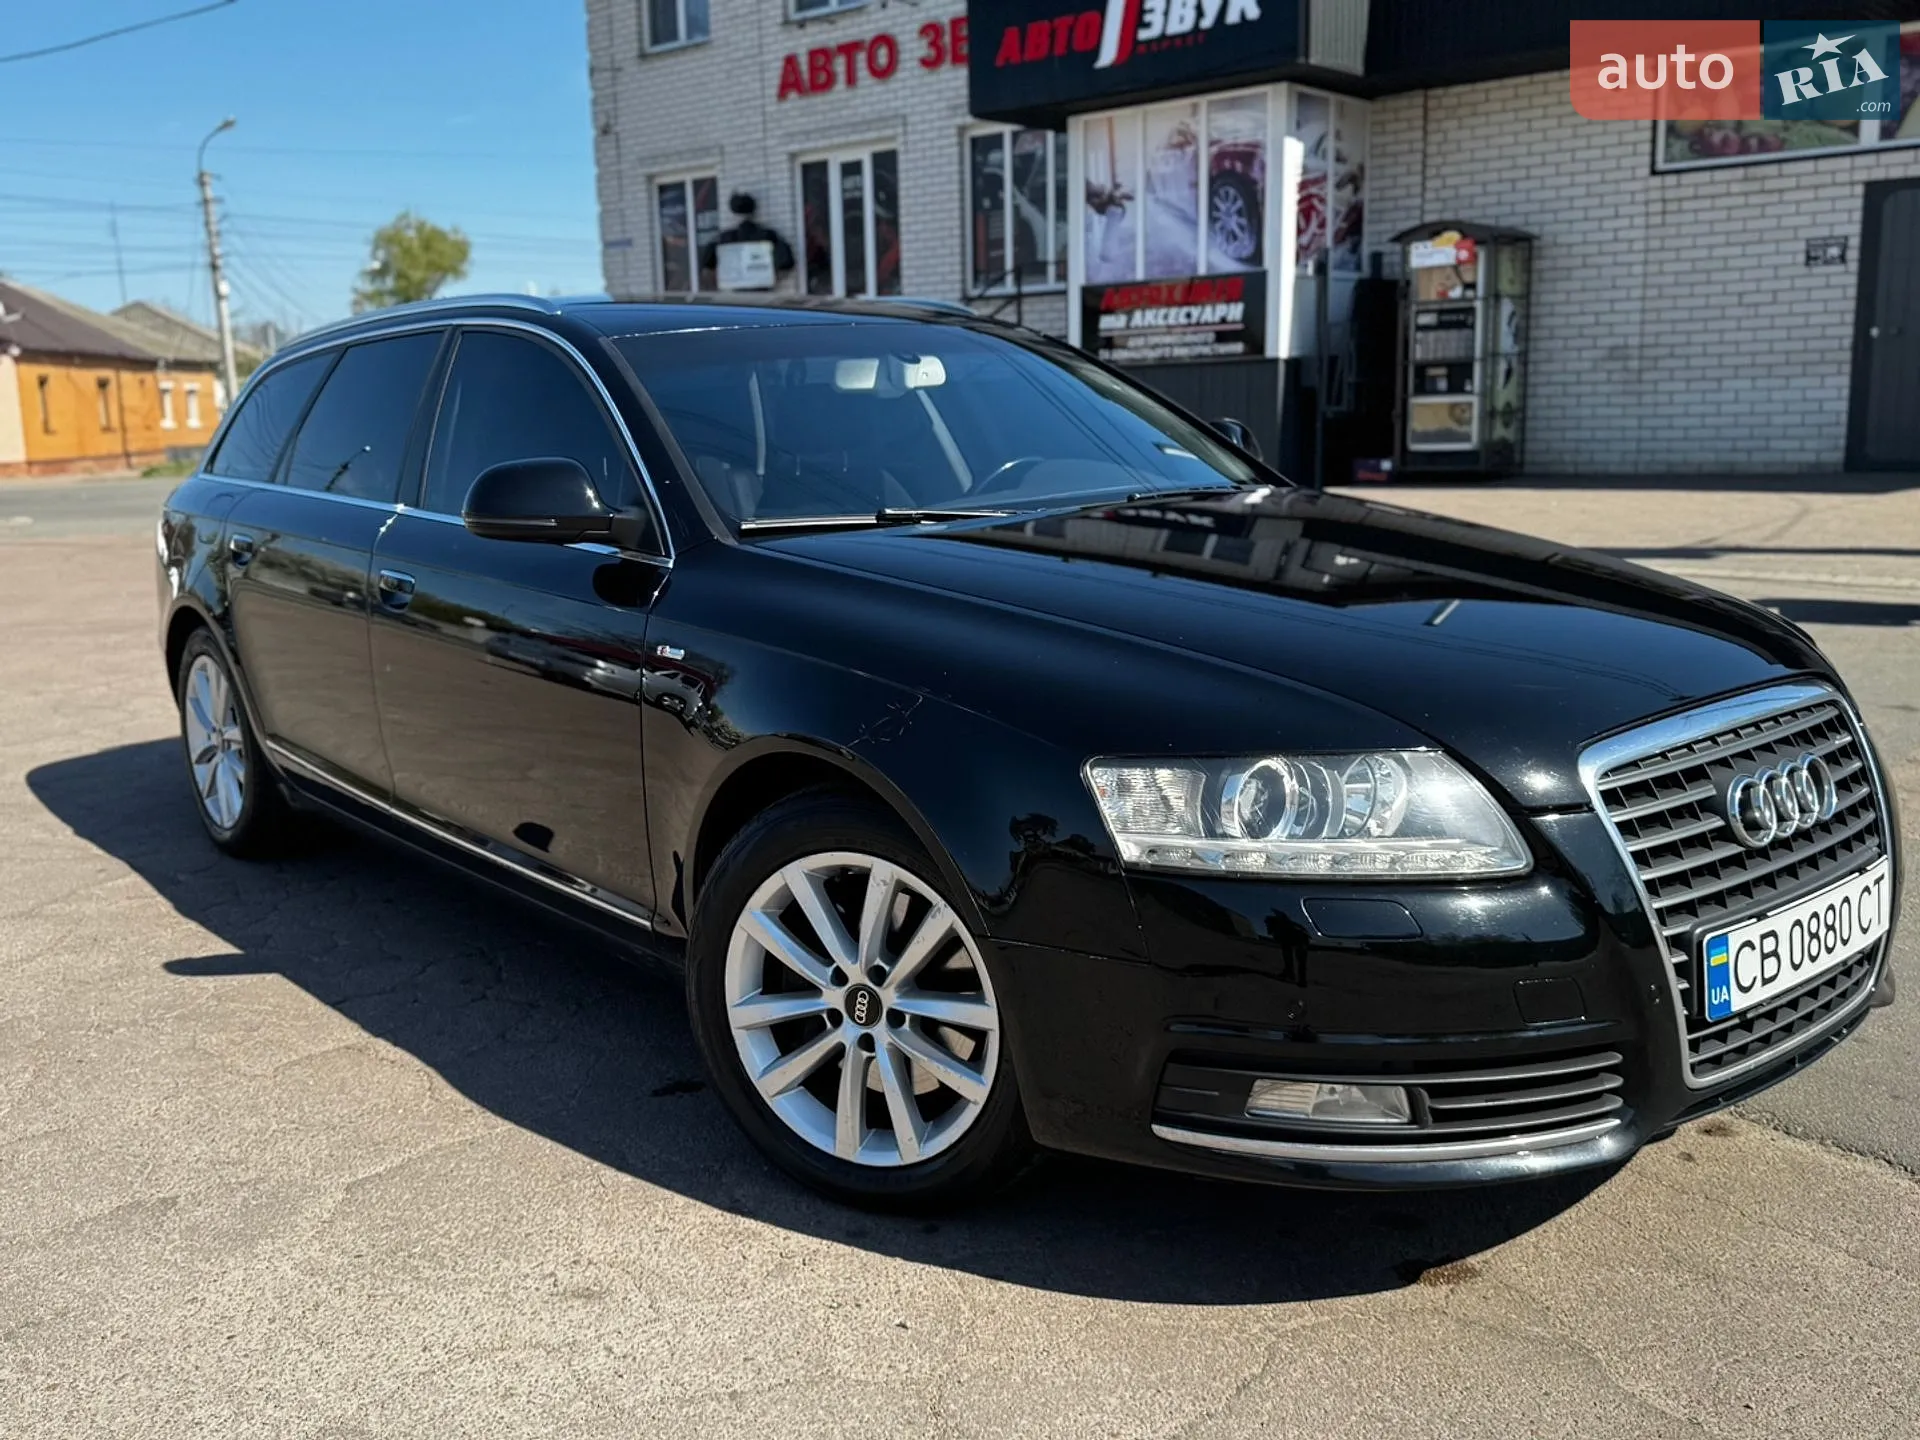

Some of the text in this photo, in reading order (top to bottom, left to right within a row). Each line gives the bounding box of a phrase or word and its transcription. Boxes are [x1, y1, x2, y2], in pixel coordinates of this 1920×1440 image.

[995, 10, 1101, 67] АВТО
[777, 33, 898, 102] АВТО
[1129, 301, 1245, 328] АКСЕСУАРИ
[1734, 873, 1885, 994] CB 0880 CT
[1711, 985, 1730, 1005] UA
